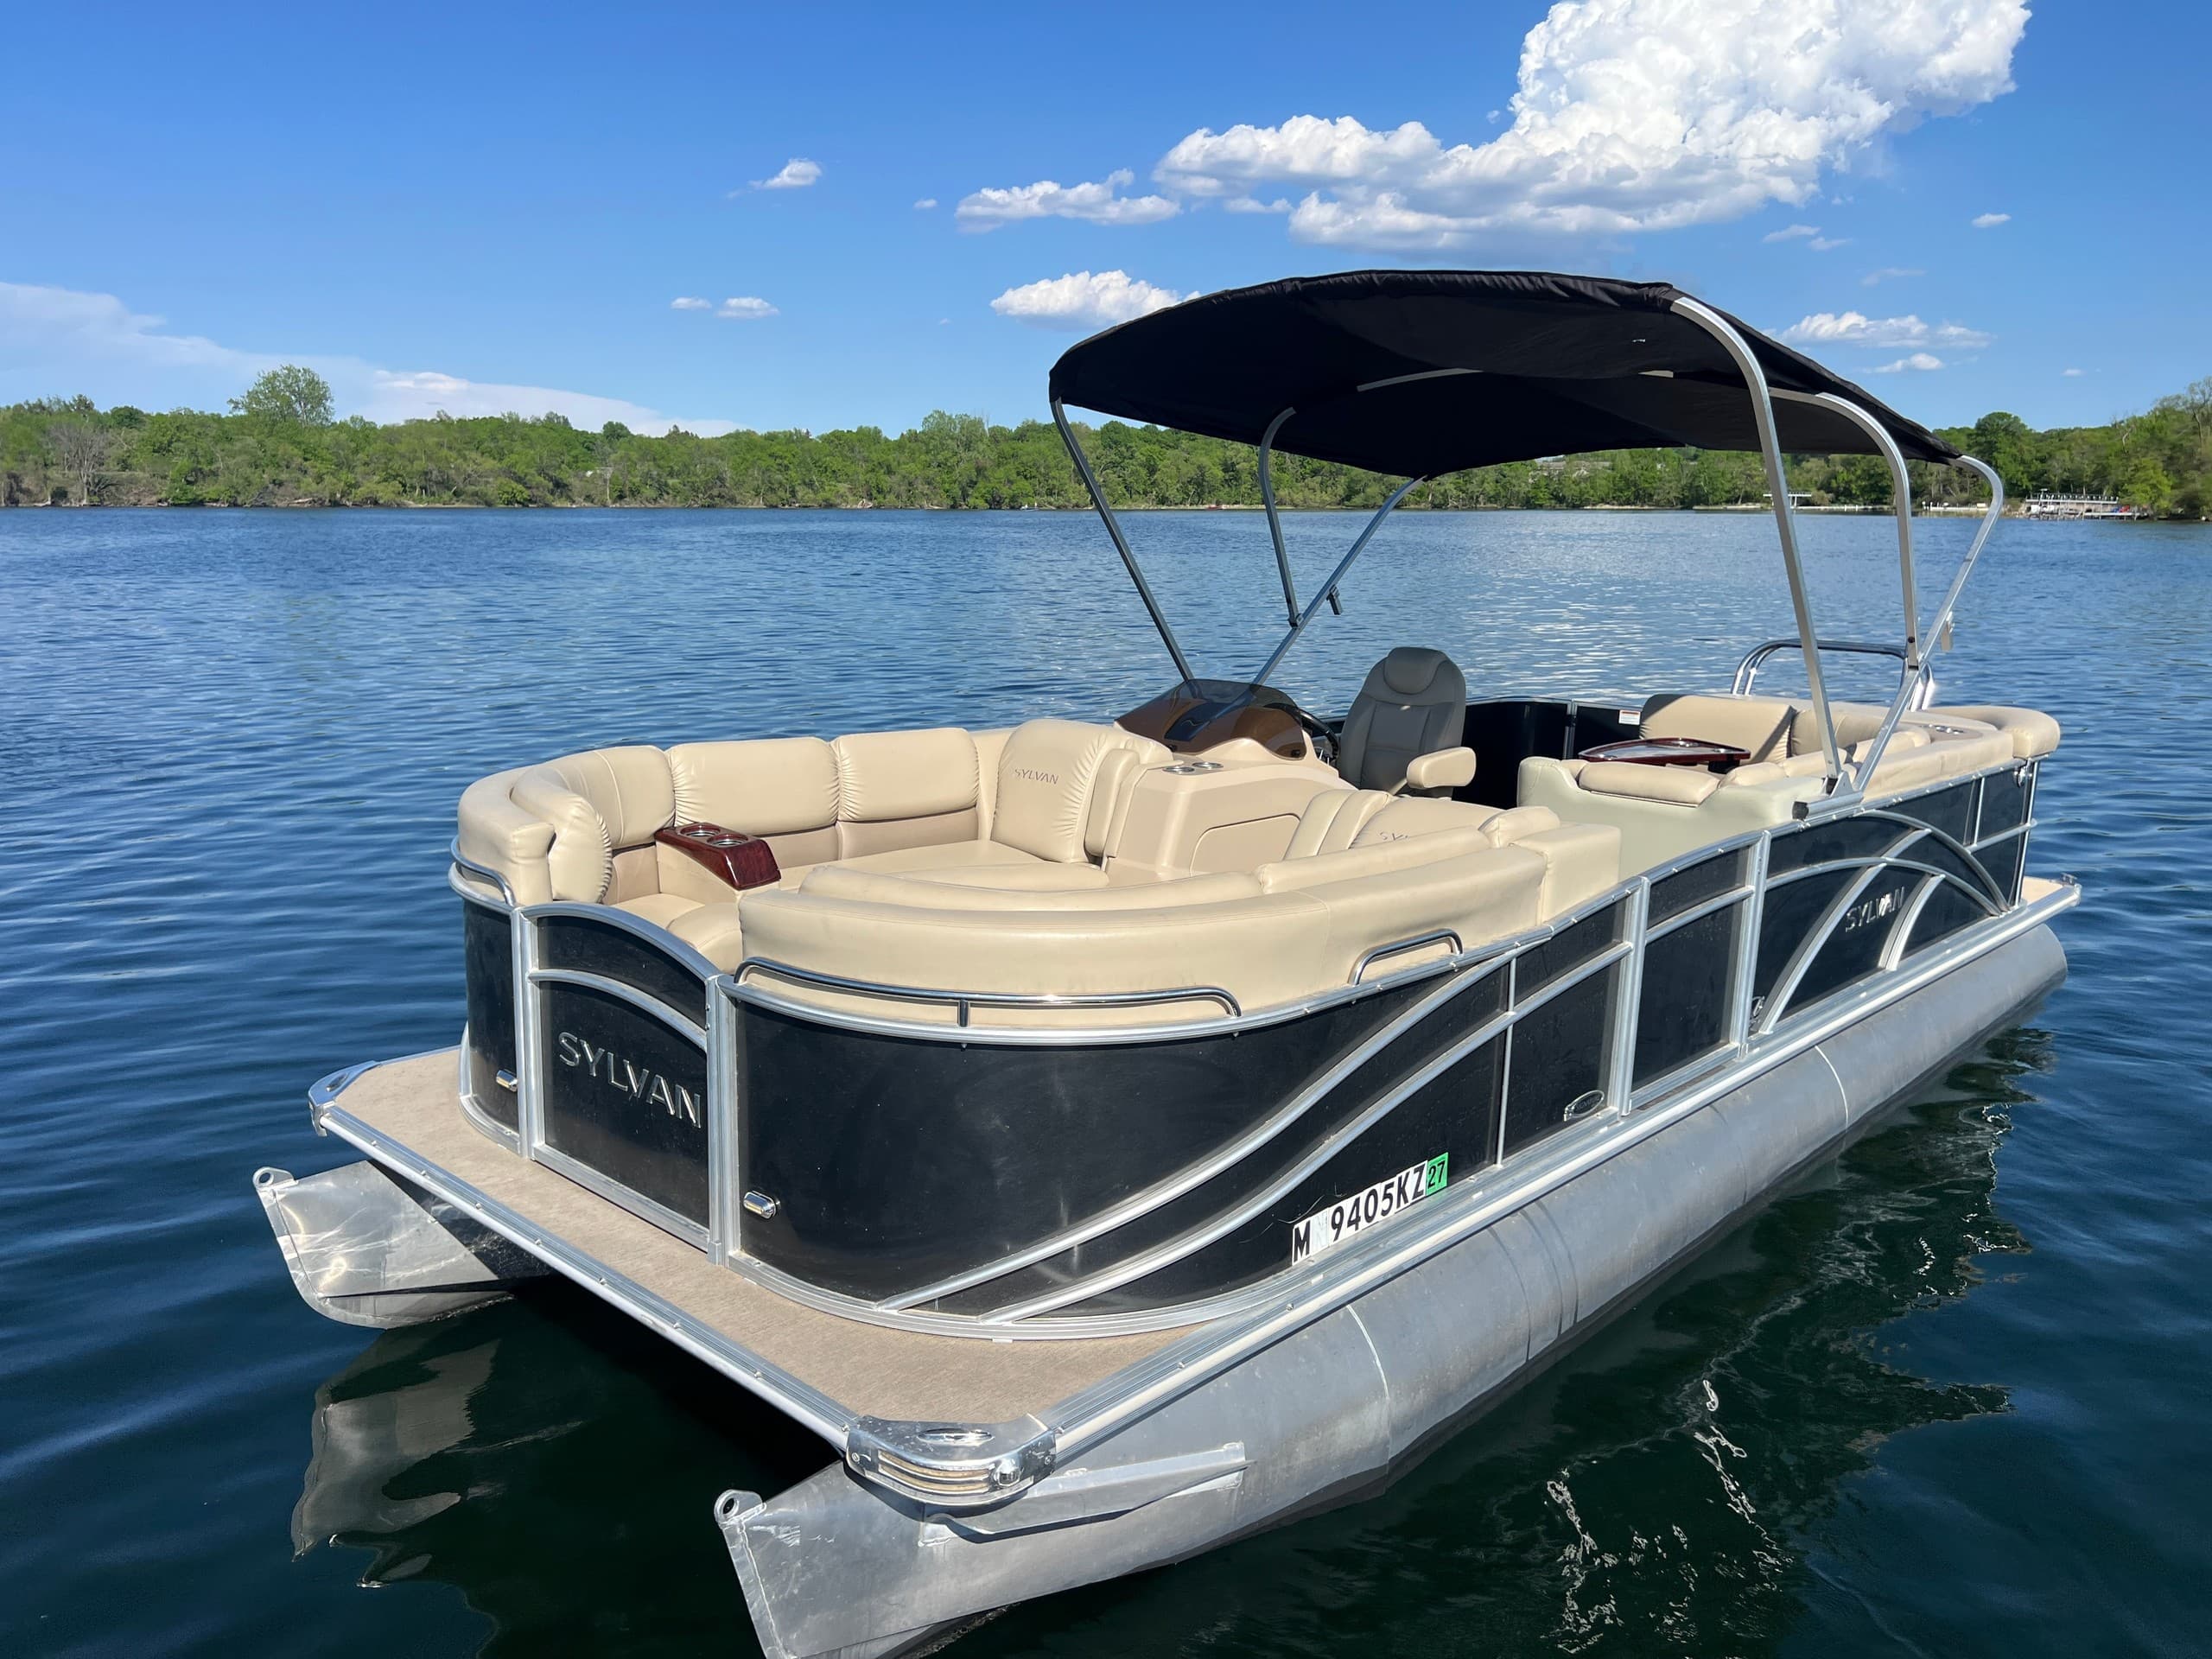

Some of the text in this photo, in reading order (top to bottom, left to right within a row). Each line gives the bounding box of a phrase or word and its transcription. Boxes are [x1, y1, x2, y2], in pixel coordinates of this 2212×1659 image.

[1014, 768, 1059, 785] SYLVAN
[1845, 886, 1904, 933] SYLVAN
[558, 1031, 702, 1128] SYLVAN
[1427, 1160, 1446, 1189] 27
[1331, 1163, 1427, 1243] 9405KZ
